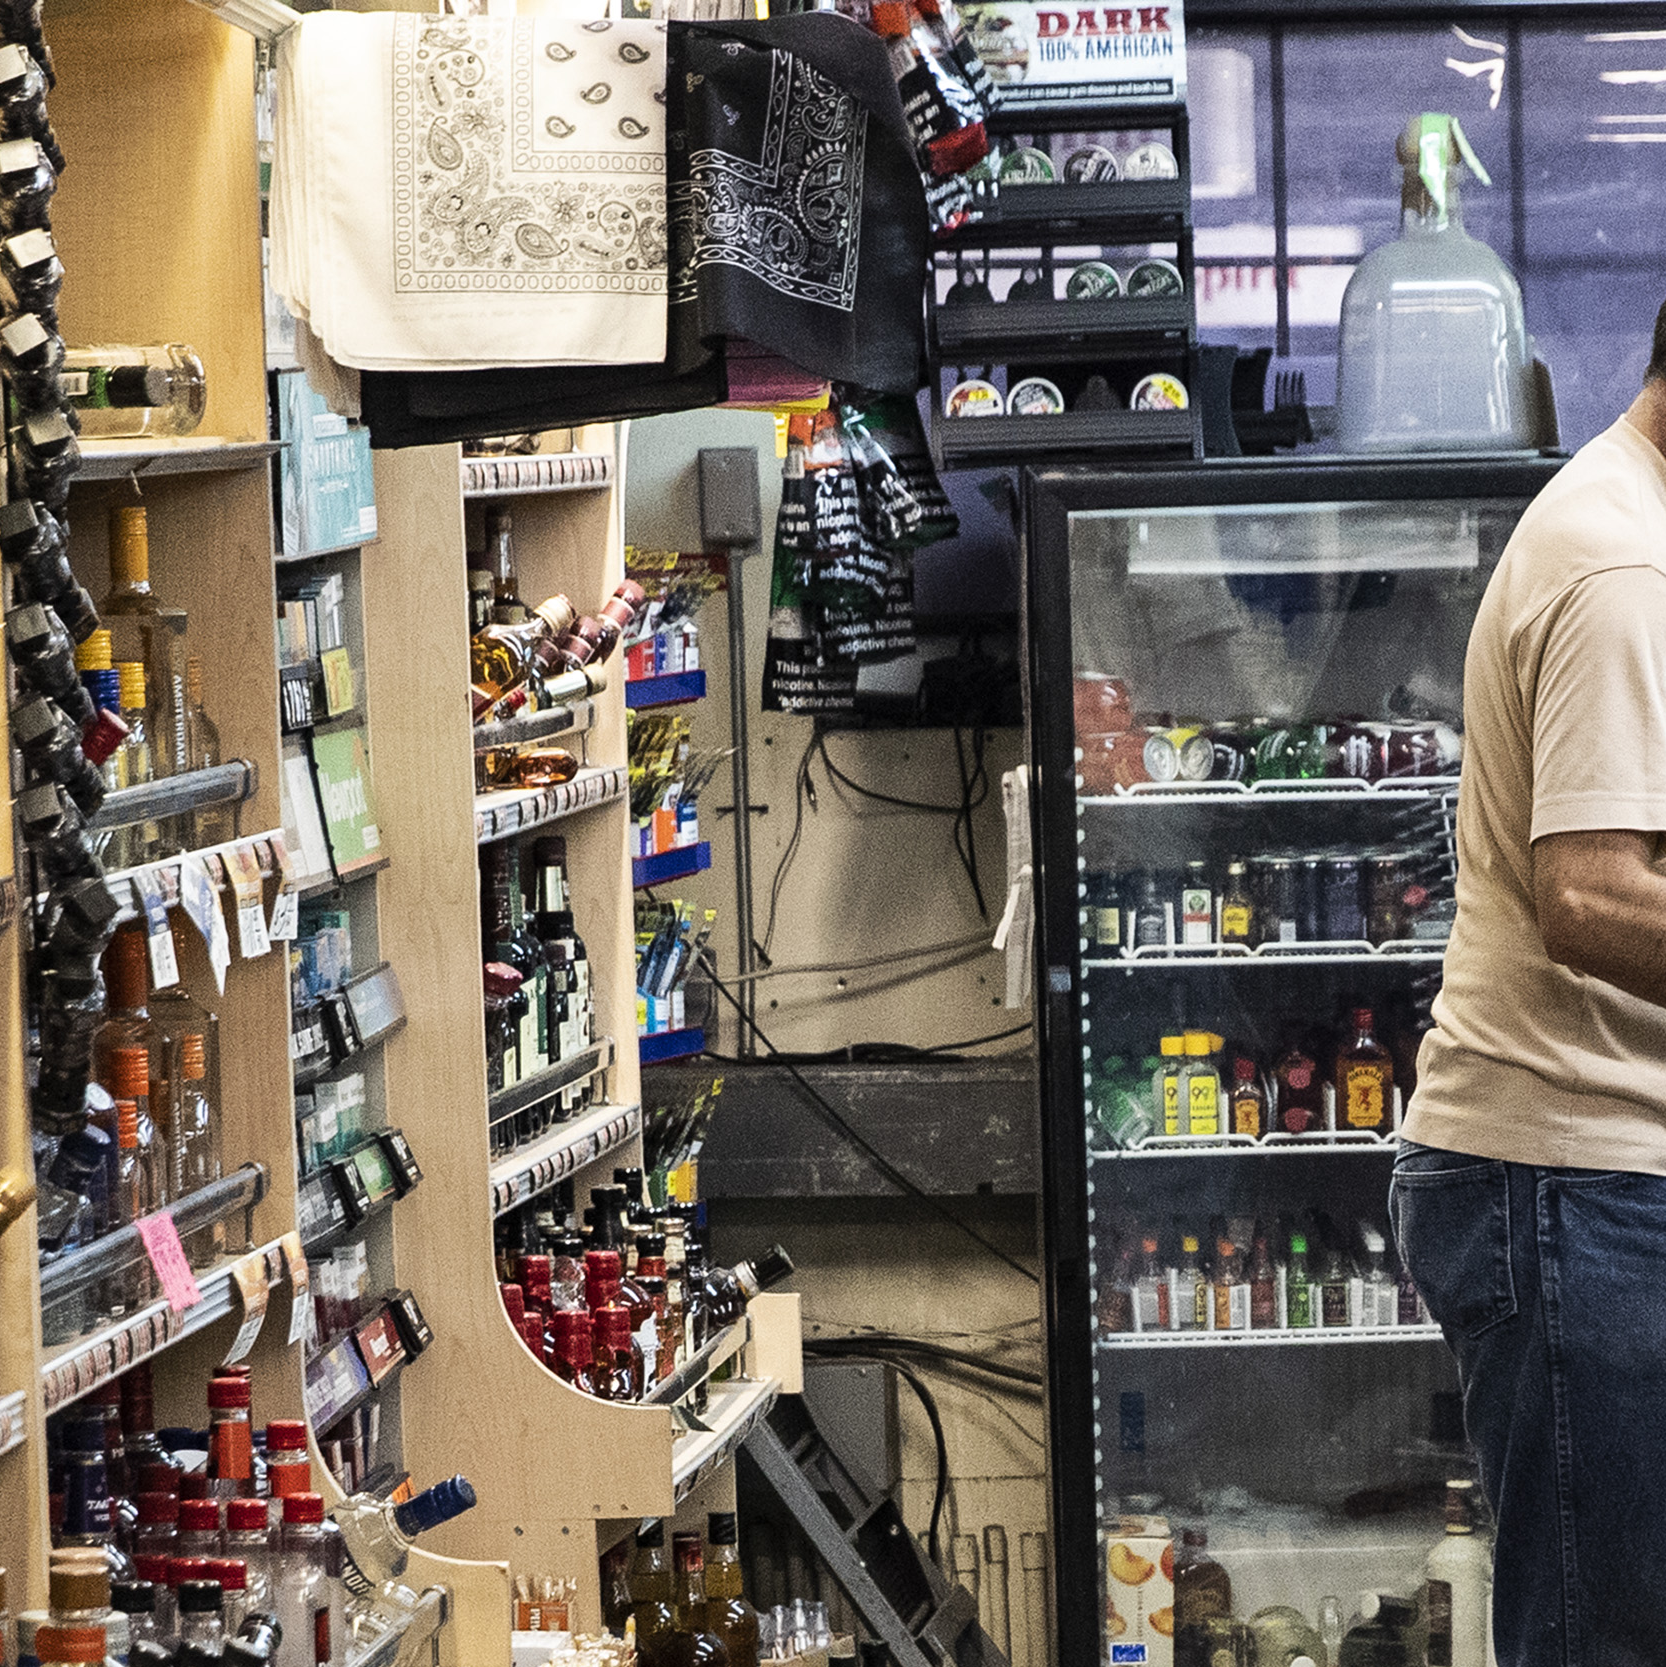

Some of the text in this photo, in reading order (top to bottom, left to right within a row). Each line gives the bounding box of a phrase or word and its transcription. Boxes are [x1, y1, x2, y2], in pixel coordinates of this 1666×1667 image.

[1036, 6, 1172, 38] DARK
[1038, 35, 1174, 62] 100% AMERICAN
[173, 674, 186, 767] AMSTERDAM
